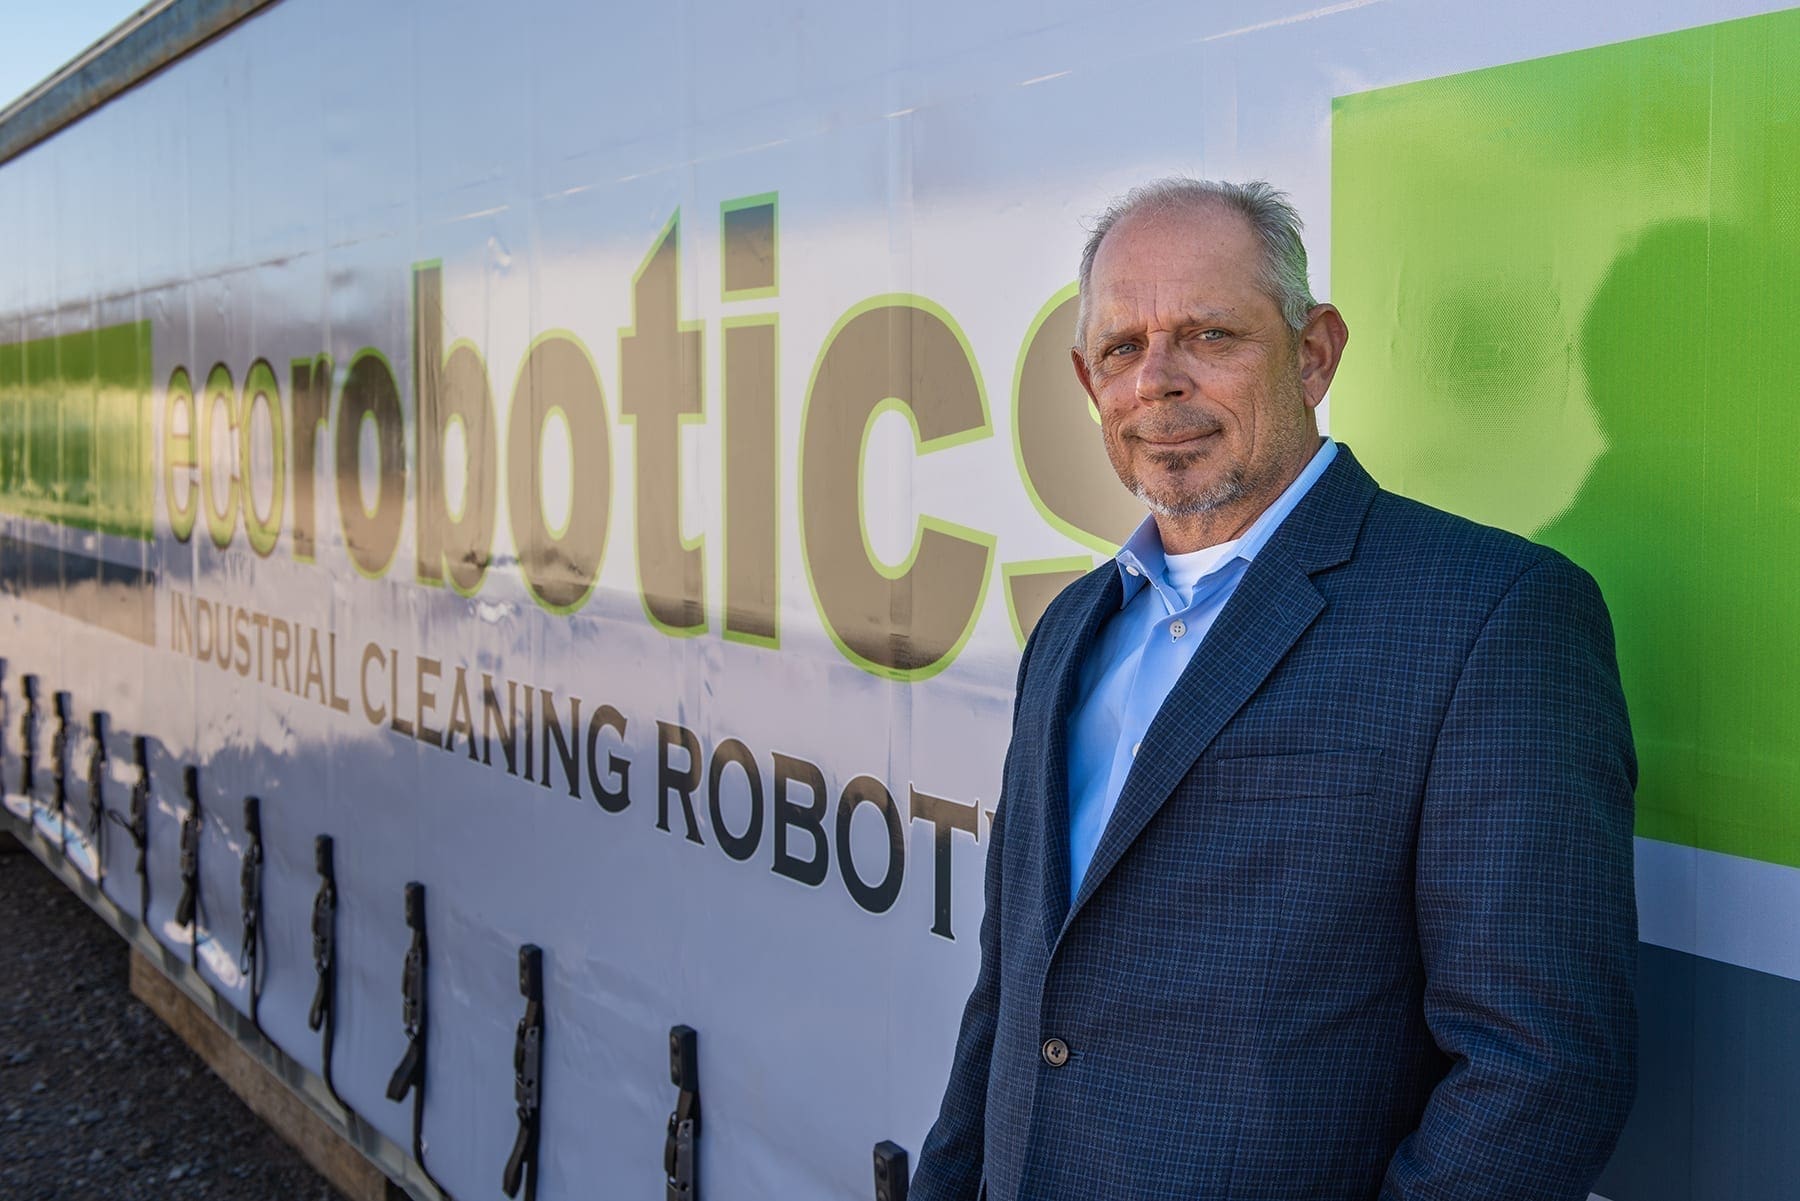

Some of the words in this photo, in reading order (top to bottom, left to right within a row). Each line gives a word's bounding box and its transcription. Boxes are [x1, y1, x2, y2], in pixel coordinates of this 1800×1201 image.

[170, 590, 350, 714] INDUSTRIAL
[360, 642, 632, 813] CLEANING
[654, 719, 996, 942] ROBOT
